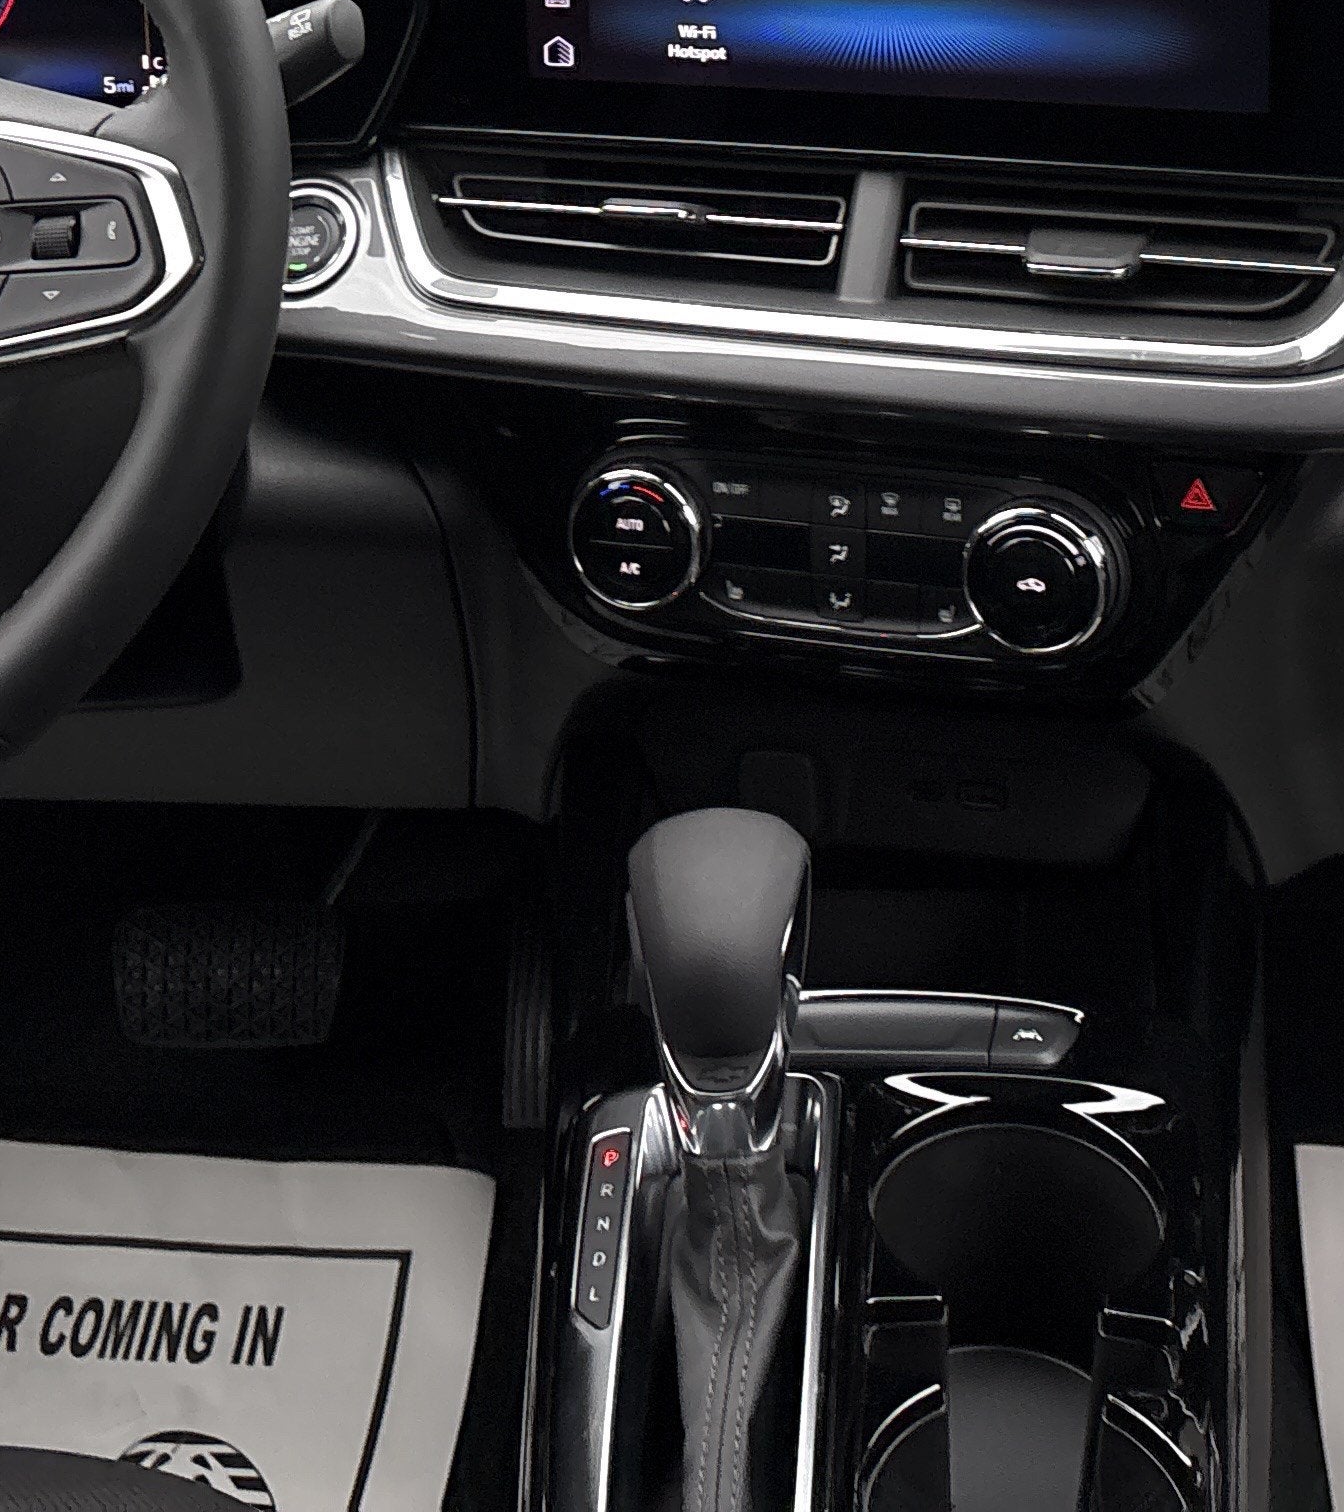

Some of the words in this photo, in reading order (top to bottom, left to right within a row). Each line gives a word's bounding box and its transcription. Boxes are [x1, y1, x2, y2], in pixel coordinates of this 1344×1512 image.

[677, 24, 717, 40] Wi-Fi
[667, 44, 728, 63] Hotspot
[288, 233, 320, 247] NGINE
[615, 517, 644, 532] AUTO
[619, 561, 641, 576] A/C
[603, 1149, 619, 1167] P
[600, 1183, 614, 1198] R
[596, 1216, 610, 1232] N
[592, 1251, 606, 1267] D
[589, 1286, 599, 1302] L
[39, 1295, 219, 1365] COMING
[231, 1304, 285, 1367] IN
